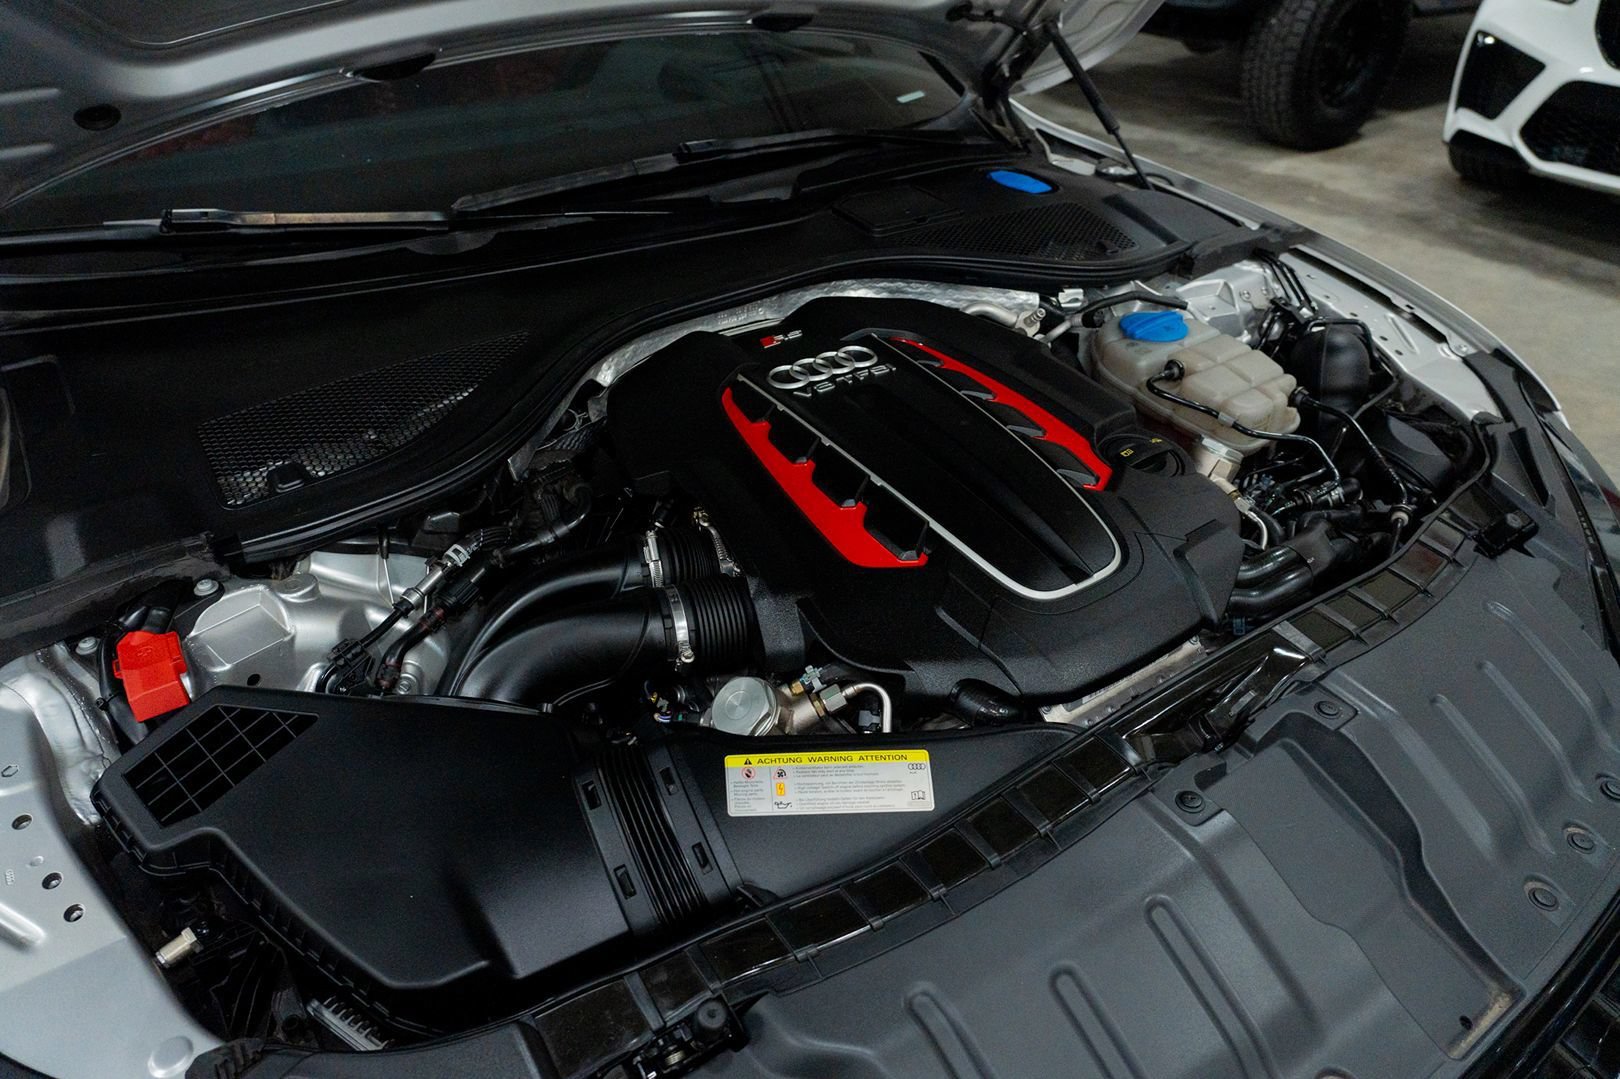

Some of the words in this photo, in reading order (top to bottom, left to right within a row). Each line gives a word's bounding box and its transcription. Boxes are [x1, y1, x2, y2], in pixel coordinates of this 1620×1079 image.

[836, 363, 897, 384] TFSI
[757, 757, 803, 765] ACHTUNG
[808, 755, 853, 763] WARNING
[858, 754, 908, 762] ATTENTION
